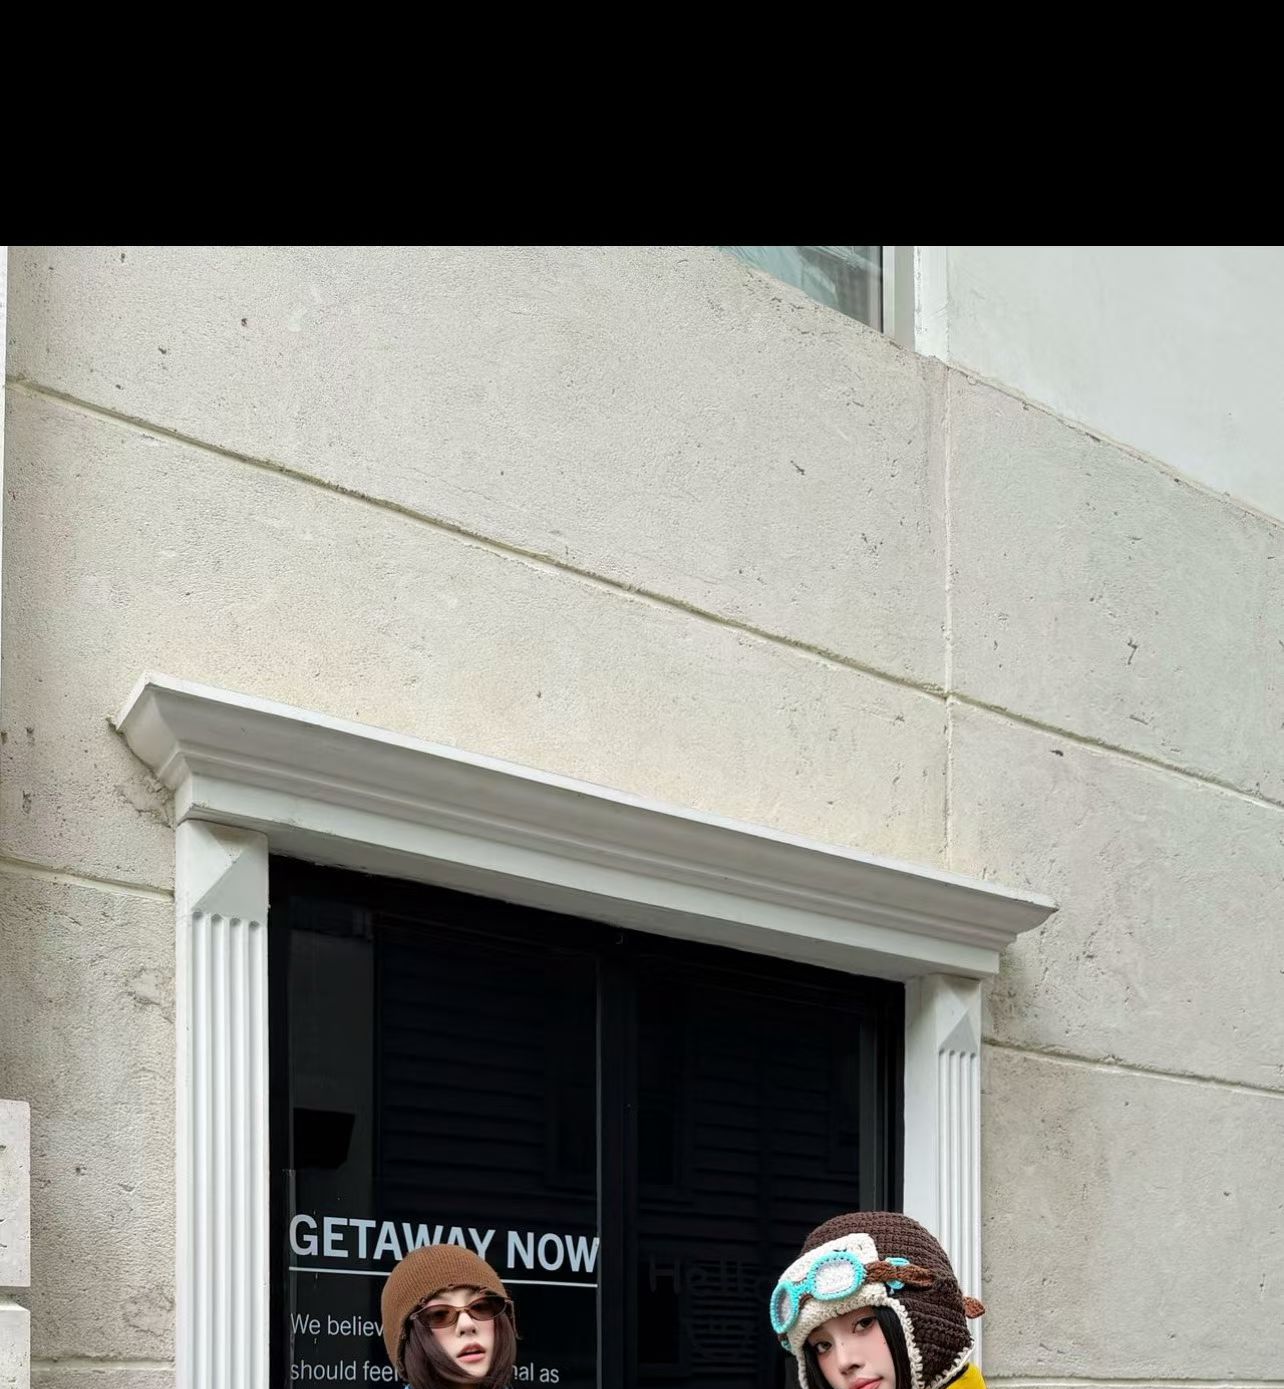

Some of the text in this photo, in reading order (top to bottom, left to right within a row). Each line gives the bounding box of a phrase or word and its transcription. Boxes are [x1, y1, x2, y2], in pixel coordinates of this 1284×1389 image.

[507, 1230, 600, 1273] NOW
[290, 1313, 384, 1337] We believ
[290, 1360, 357, 1381] should
[362, 1361, 399, 1382] feel
[539, 1368, 560, 1384] as
